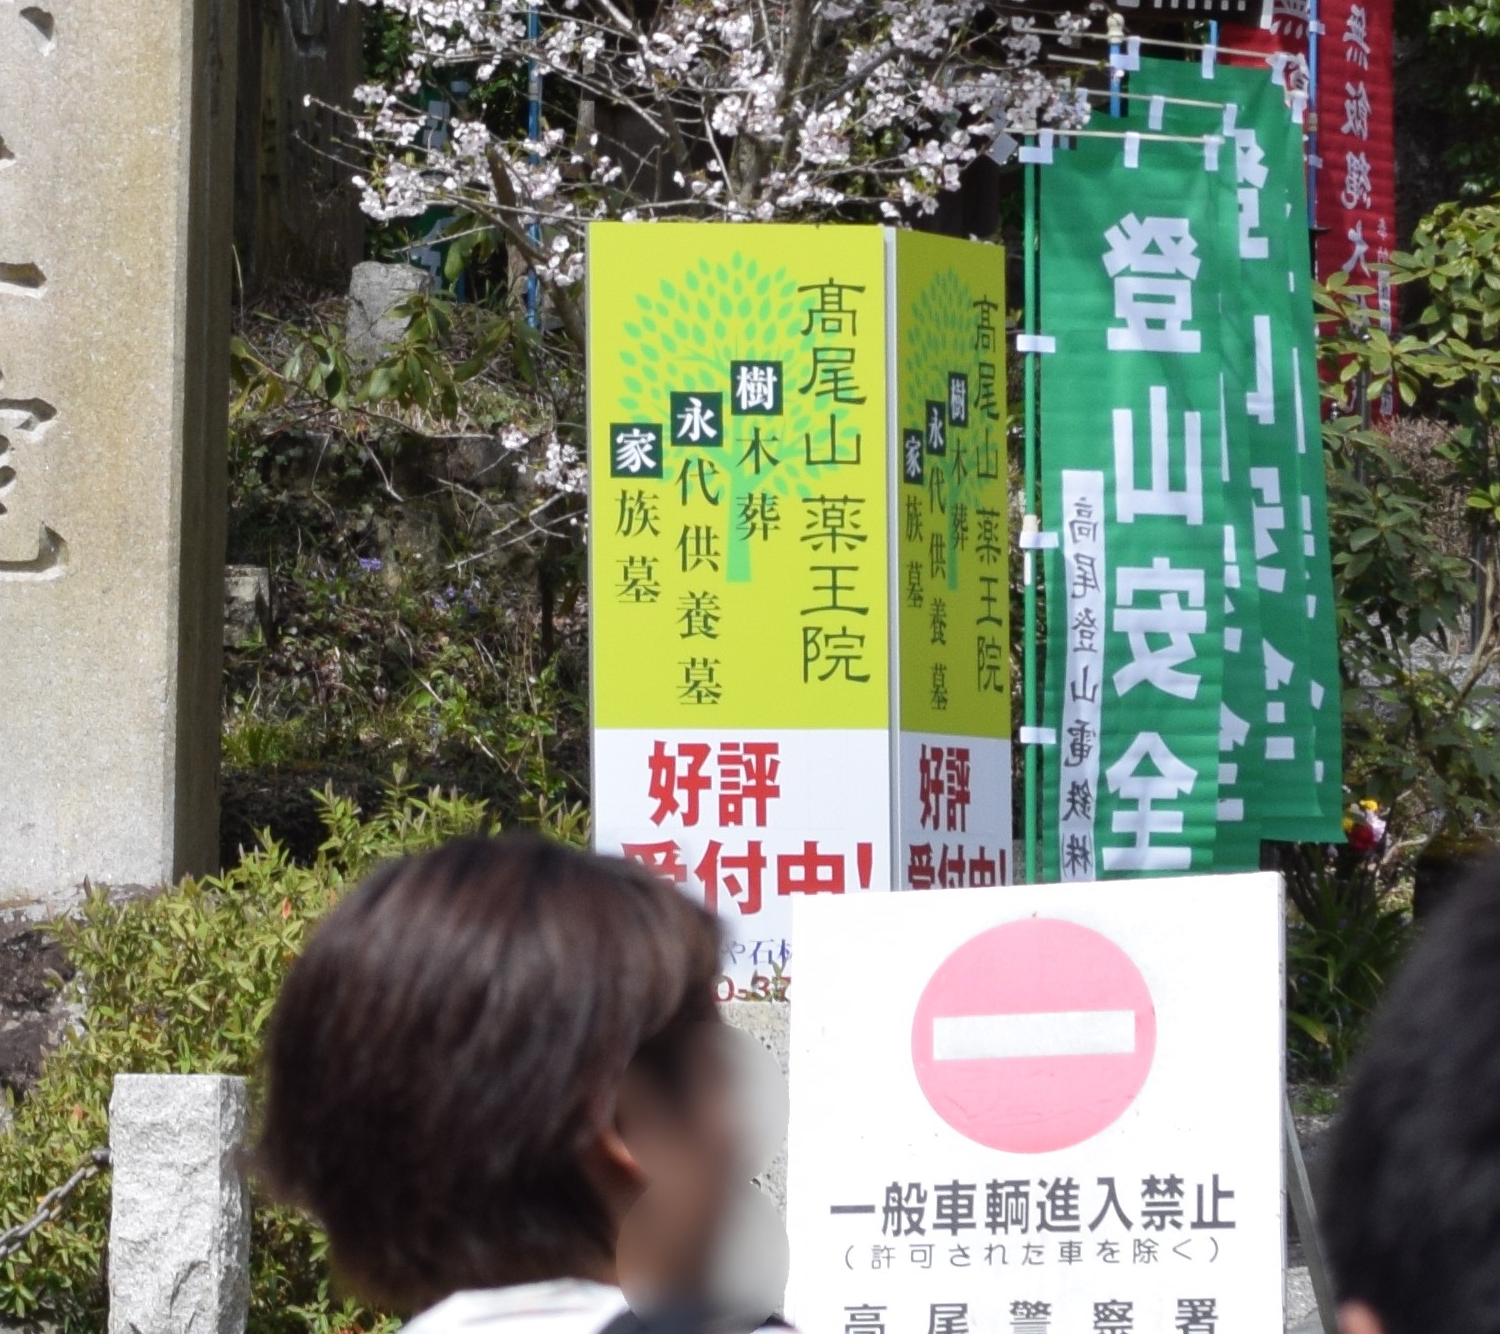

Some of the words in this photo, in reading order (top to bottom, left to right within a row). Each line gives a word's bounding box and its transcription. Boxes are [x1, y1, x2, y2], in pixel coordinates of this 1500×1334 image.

[615, 428, 660, 603] 家族墓
[735, 366, 781, 542] 樹木葬
[905, 434, 924, 608] 家族墓
[949, 377, 969, 551] 樹木葬
[675, 396, 722, 705] 永代供養墓
[926, 407, 948, 711] 永代供養墓
[648, 740, 781, 827] 好評
[919, 744, 970, 832] 好評
